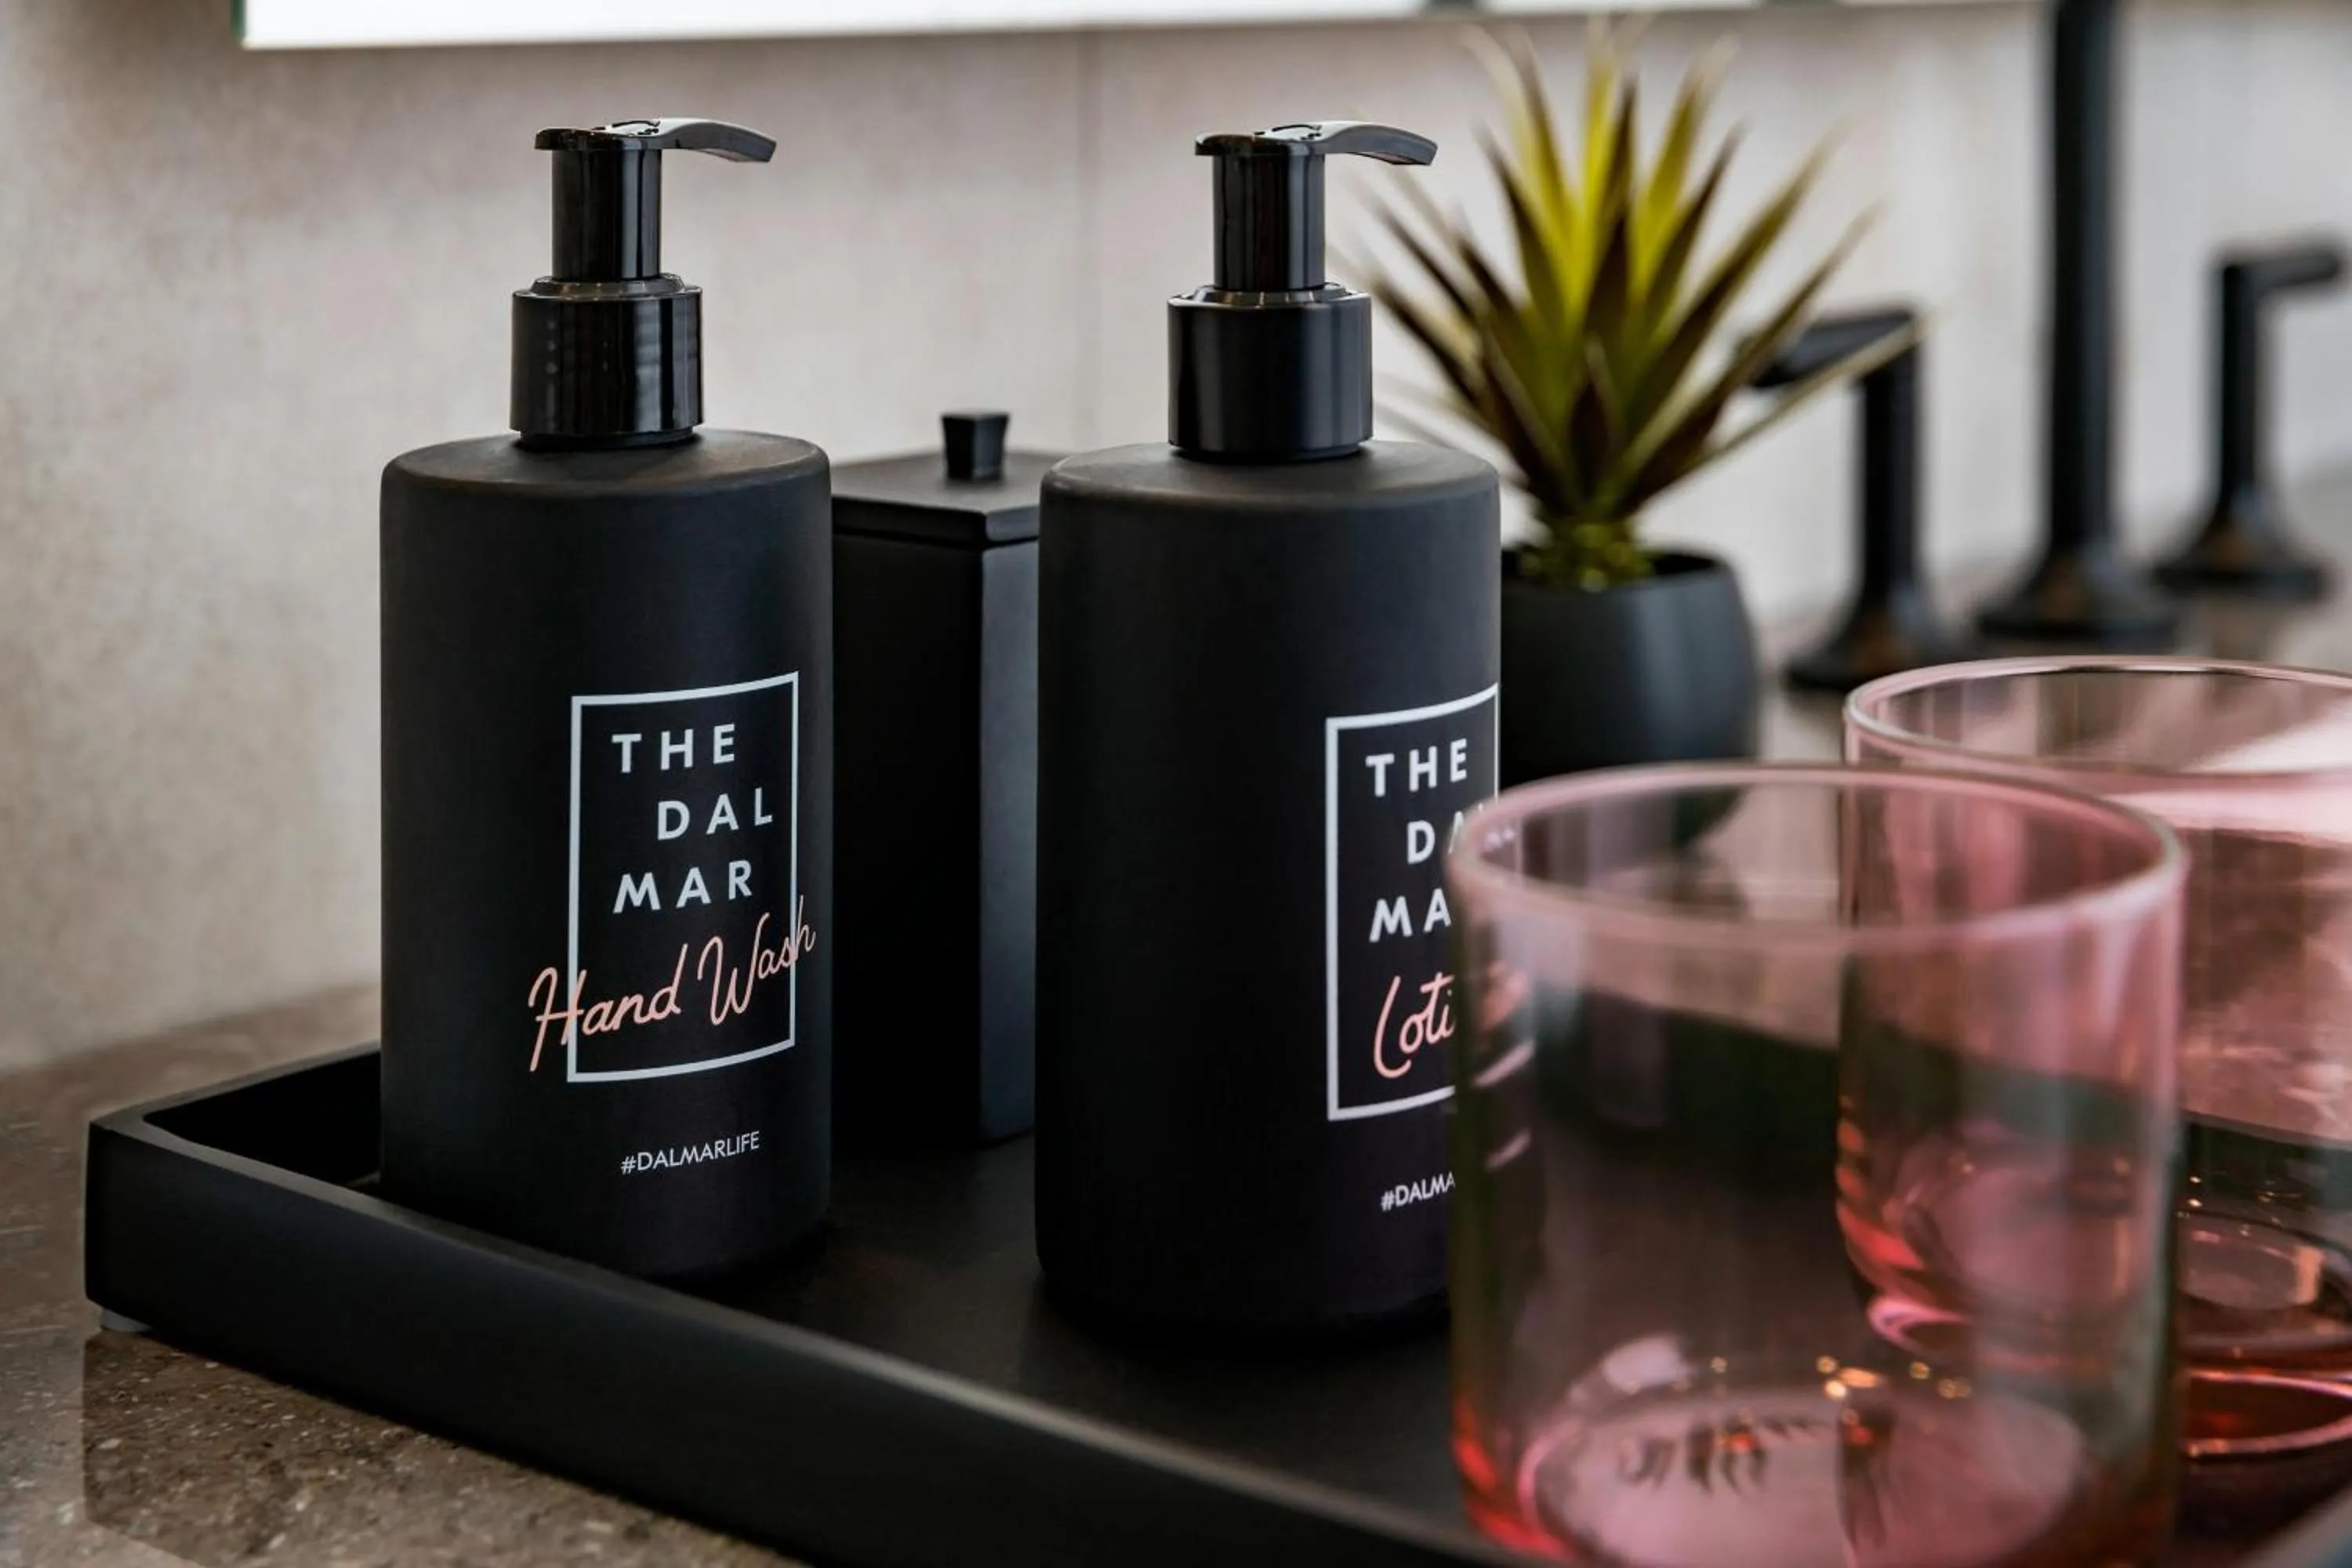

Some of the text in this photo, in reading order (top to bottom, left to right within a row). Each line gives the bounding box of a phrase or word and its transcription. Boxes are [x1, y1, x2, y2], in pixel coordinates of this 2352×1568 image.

[612, 723, 735, 773] THE
[1365, 738, 1468, 797] THE
[657, 787, 773, 840] DAL
[612, 859, 753, 914] MAR
[1369, 887, 1452, 942] MA
[528, 895, 817, 1072] Hand Wash
[1374, 971, 1455, 1078] Loti
[620, 1131, 760, 1174] #DALMARLIFE
[1381, 1171, 1456, 1211] #DALMA
